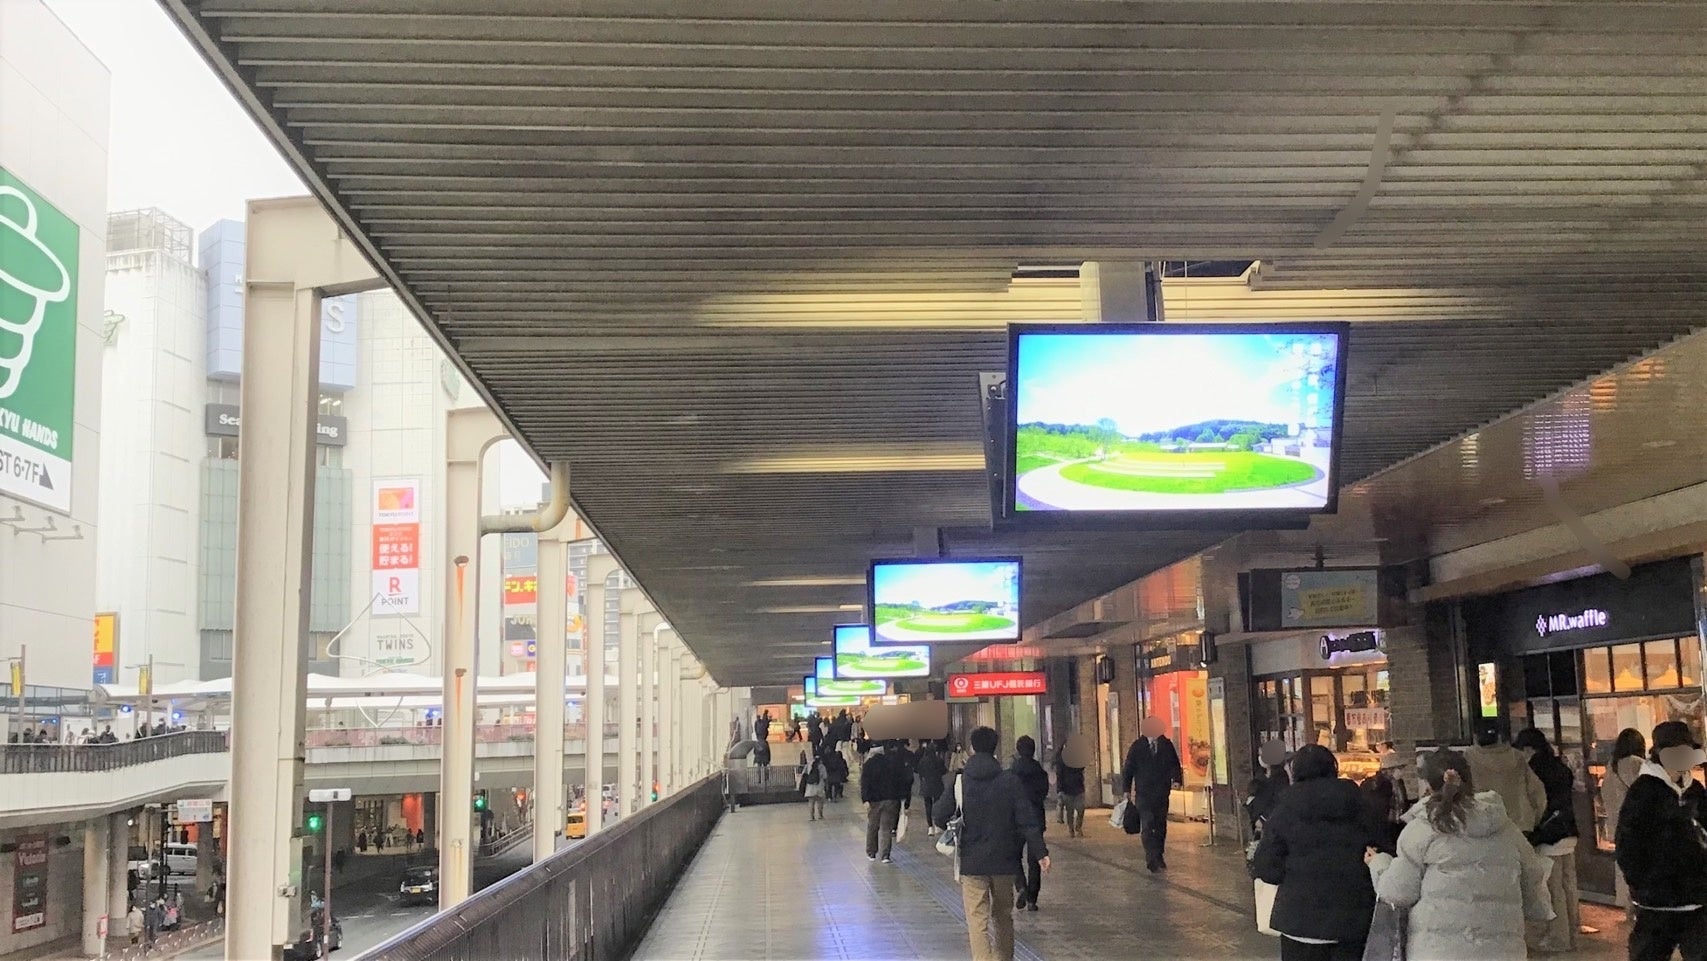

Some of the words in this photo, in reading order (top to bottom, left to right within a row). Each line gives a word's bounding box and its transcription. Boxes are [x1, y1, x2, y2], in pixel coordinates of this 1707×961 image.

[22, 418, 58, 450] HANDS
[381, 597, 409, 606] POINT
[376, 639, 414, 650] TWINS
